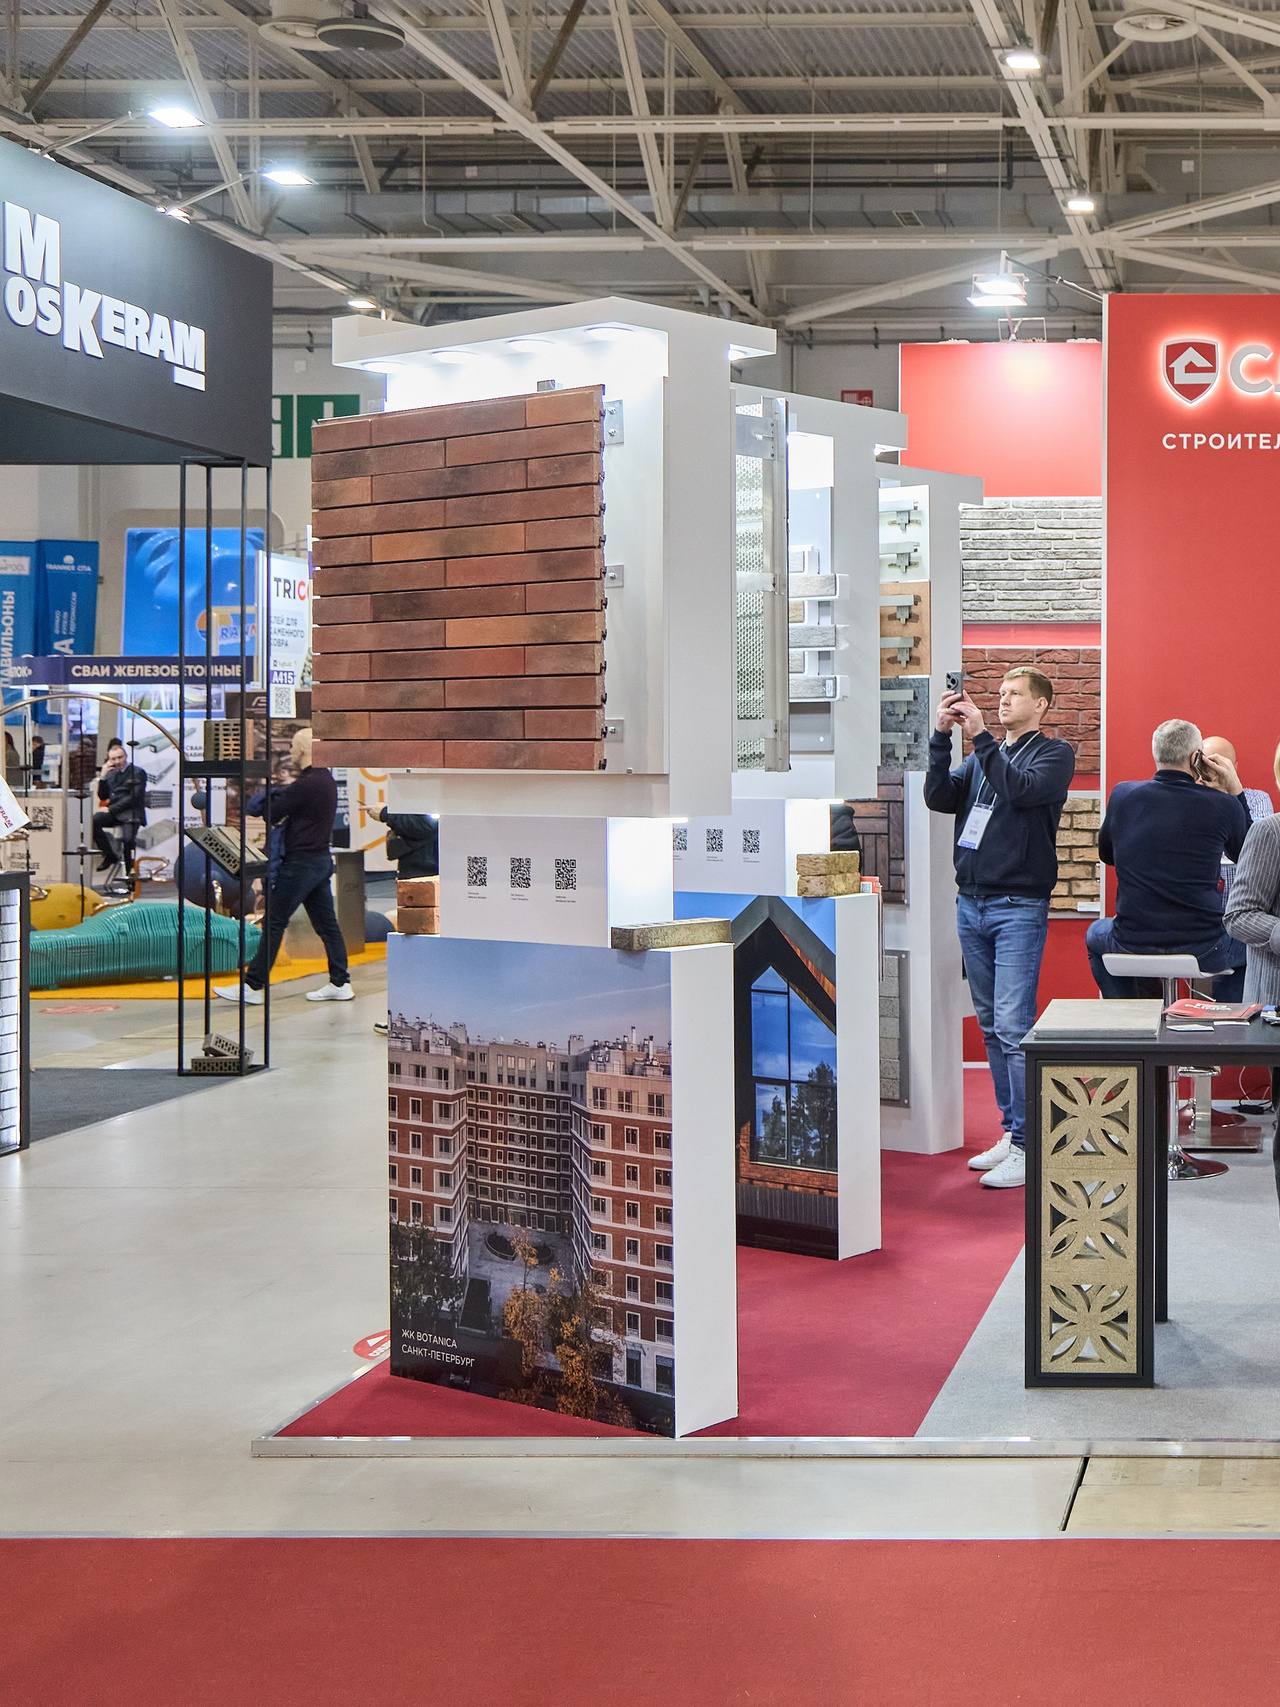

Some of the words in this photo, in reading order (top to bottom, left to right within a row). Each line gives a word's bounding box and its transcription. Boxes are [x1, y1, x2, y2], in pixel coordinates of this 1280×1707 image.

[270, 626, 305, 639] АМЕННОГО
[271, 639, 289, 648] ОВРА
[71, 664, 110, 677] СВАИ
[272, 671, 294, 684] A415
[401, 1328, 415, 1340] ЖК
[416, 1331, 458, 1349] BOTANICA
[401, 1343, 475, 1368] САНКТ-ПЕТЕРБУРГ
